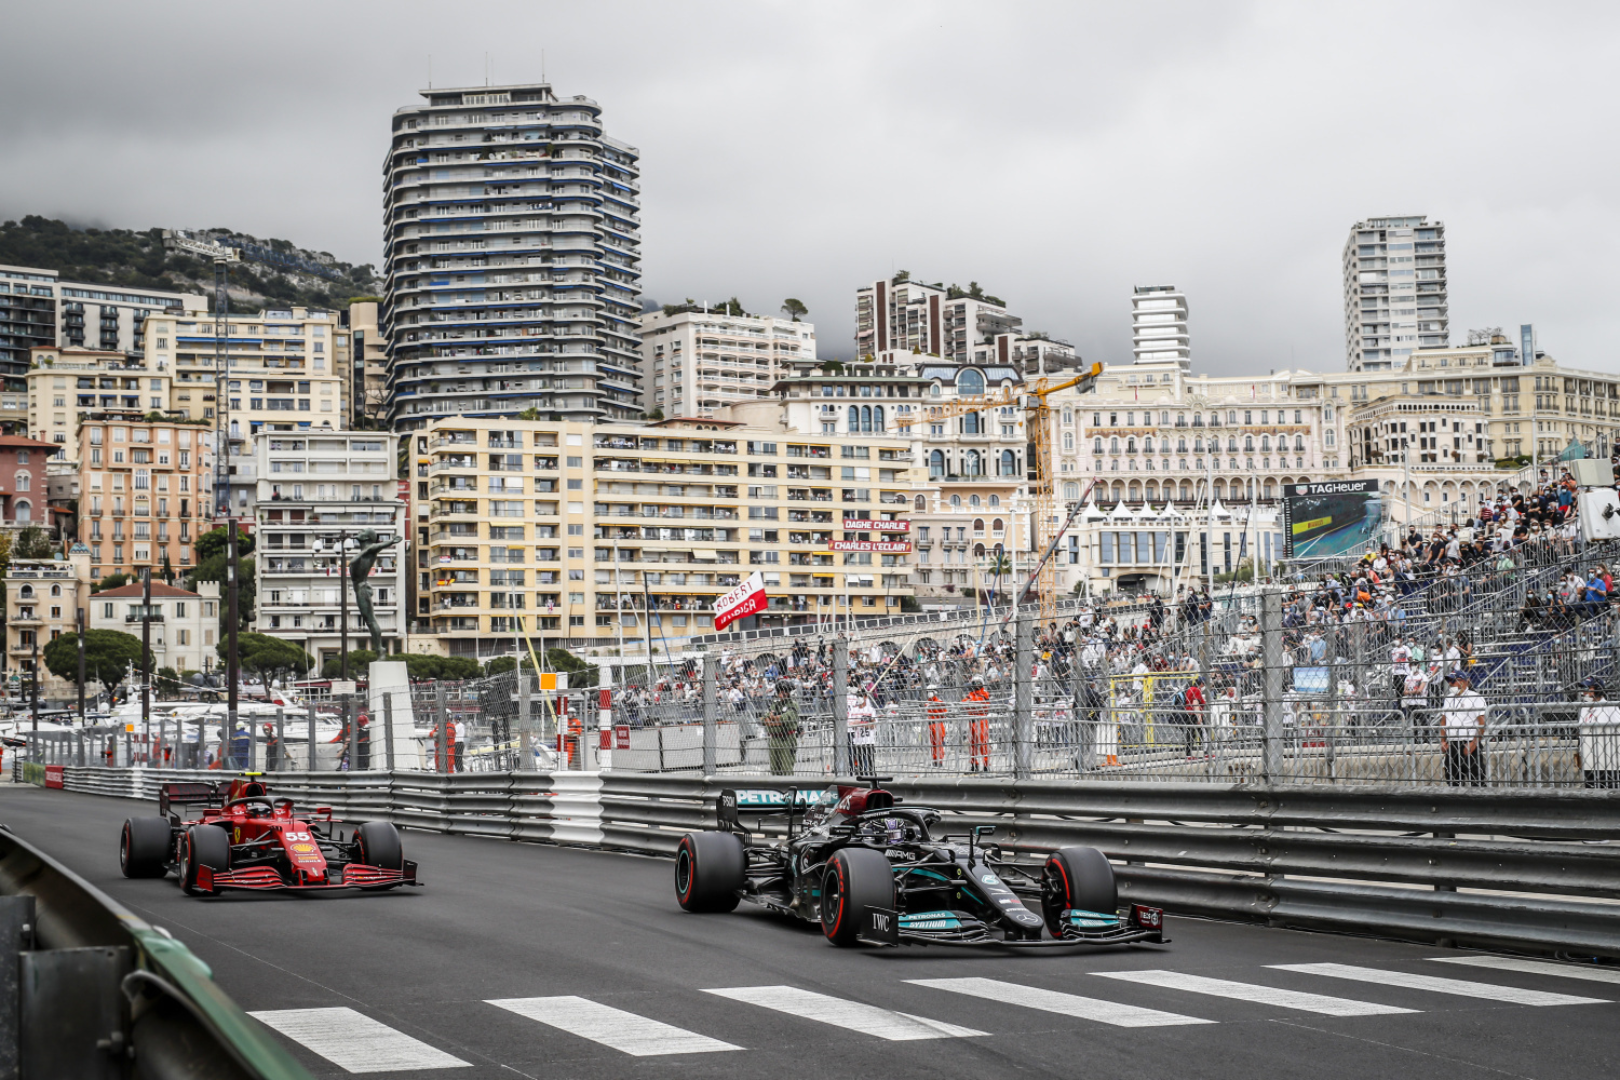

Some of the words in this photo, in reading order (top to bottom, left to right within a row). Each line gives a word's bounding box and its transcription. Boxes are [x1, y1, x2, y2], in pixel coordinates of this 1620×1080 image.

[845, 520, 872, 529] DAGHE
[873, 521, 907, 530] CHARLIE
[834, 541, 871, 550] CHARLES
[872, 542, 906, 551] L'ECLAIR
[285, 832, 311, 842] 55
[894, 850, 916, 861] AMG
[908, 912, 946, 920] PETRONAS
[872, 913, 890, 932] IWC
